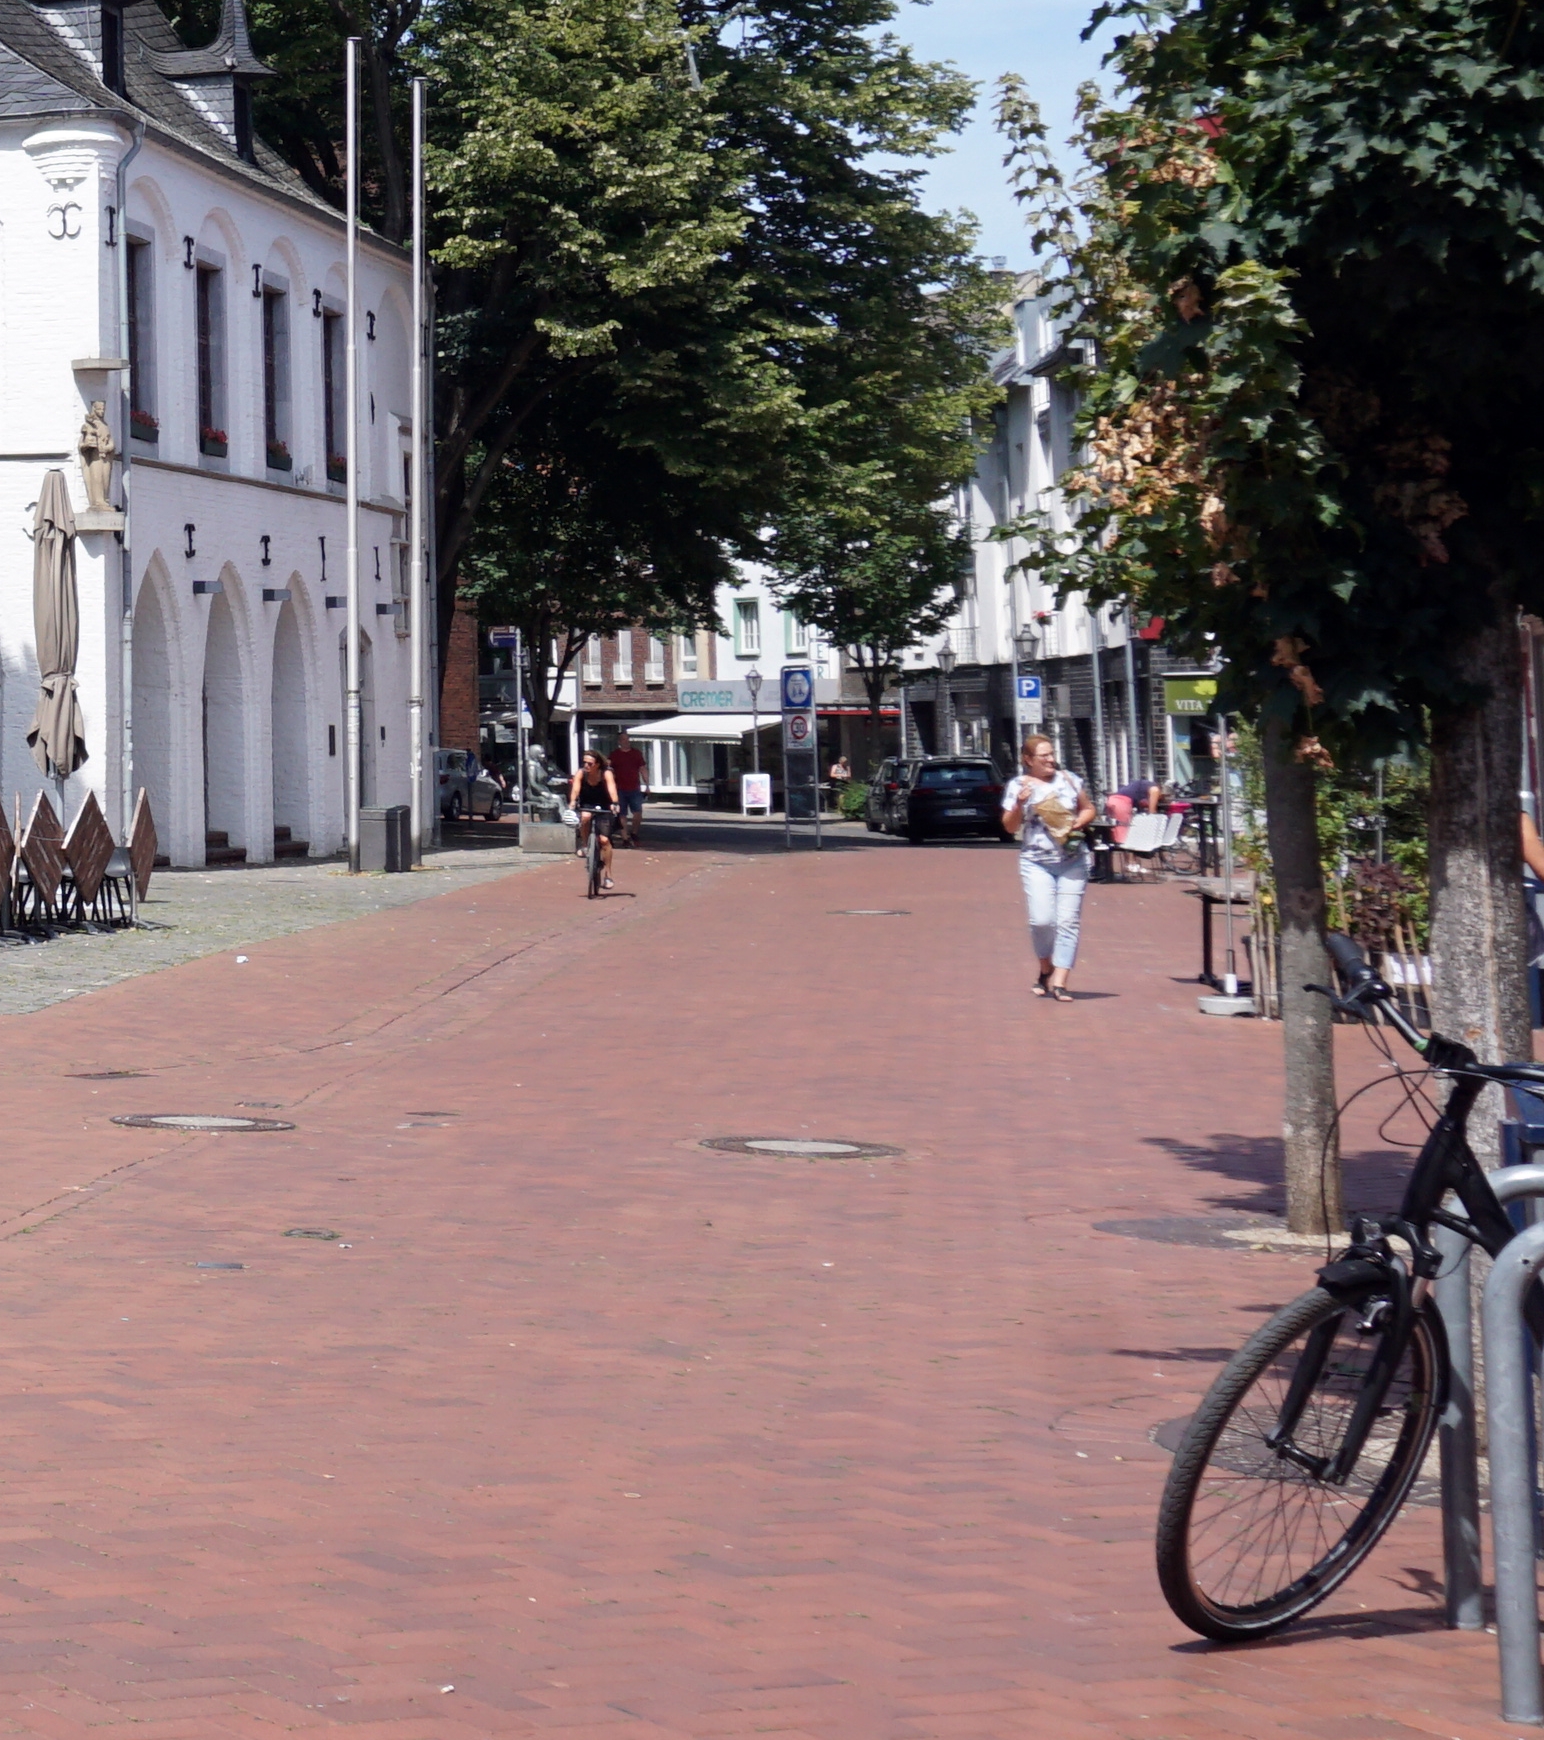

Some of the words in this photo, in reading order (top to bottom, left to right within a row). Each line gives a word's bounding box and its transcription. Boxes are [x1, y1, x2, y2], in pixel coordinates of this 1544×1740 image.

[1022, 680, 1036, 697] P
[681, 691, 733, 708] CREMER
[1175, 700, 1205, 711] VITA
